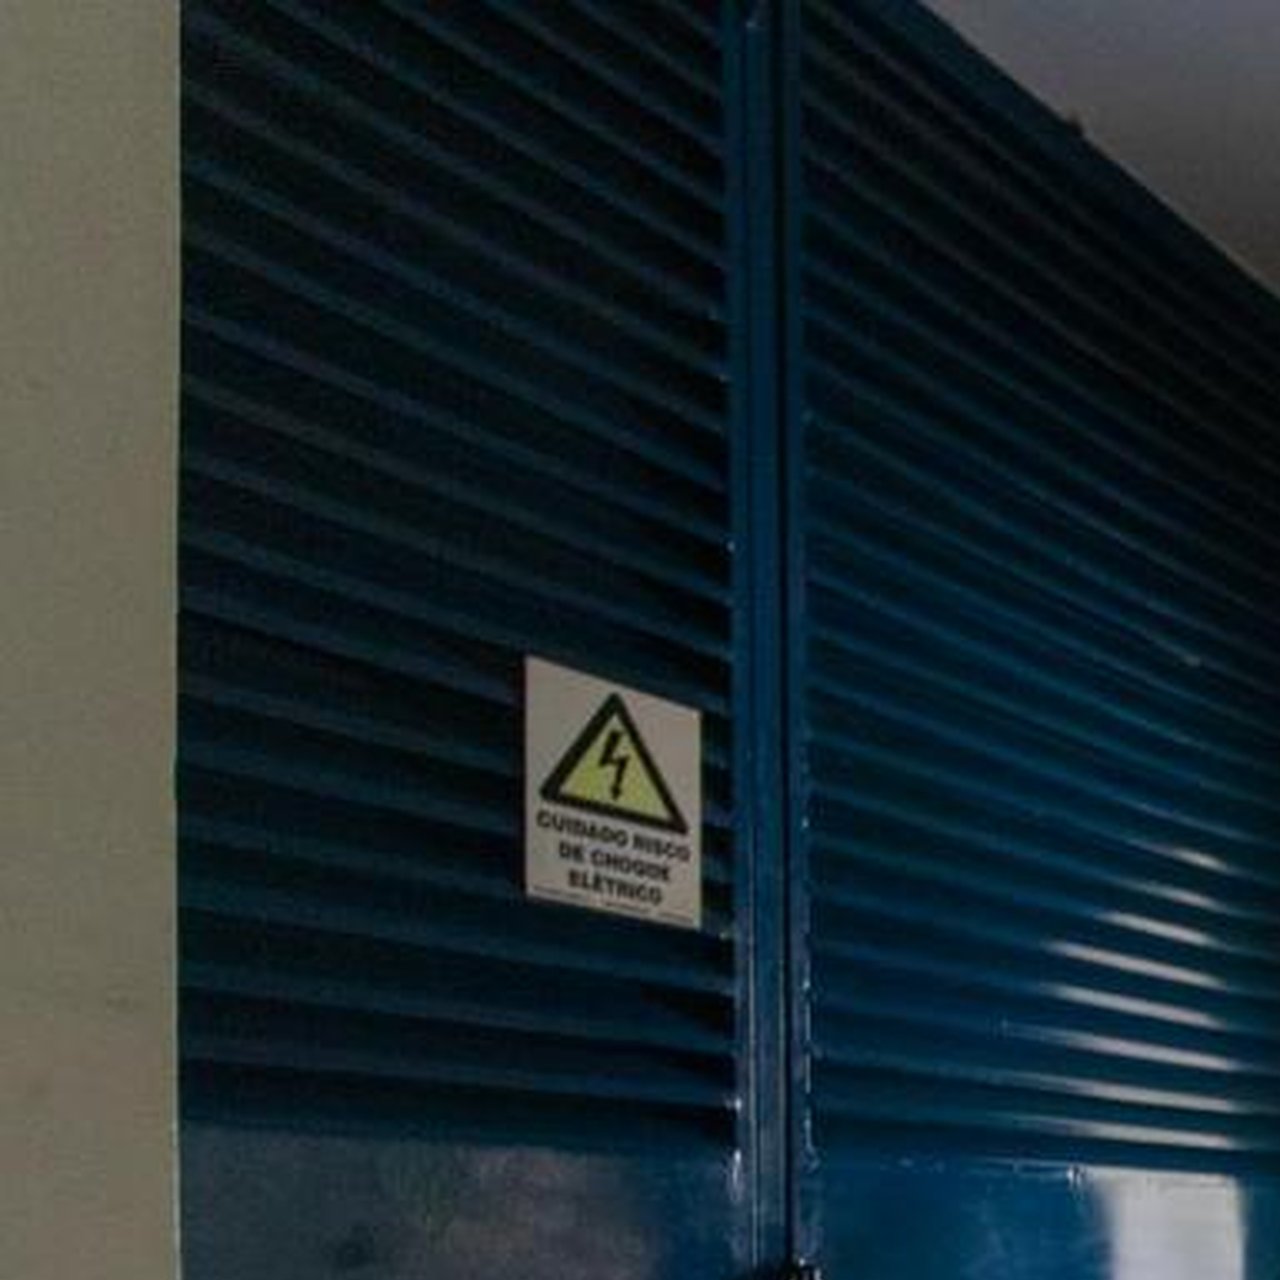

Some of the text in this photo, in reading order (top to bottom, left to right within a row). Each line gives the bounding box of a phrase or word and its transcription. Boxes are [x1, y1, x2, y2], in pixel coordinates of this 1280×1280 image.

[536, 809, 690, 862] CUIDADO RISCO
[559, 842, 670, 882] DE CHOQUE
